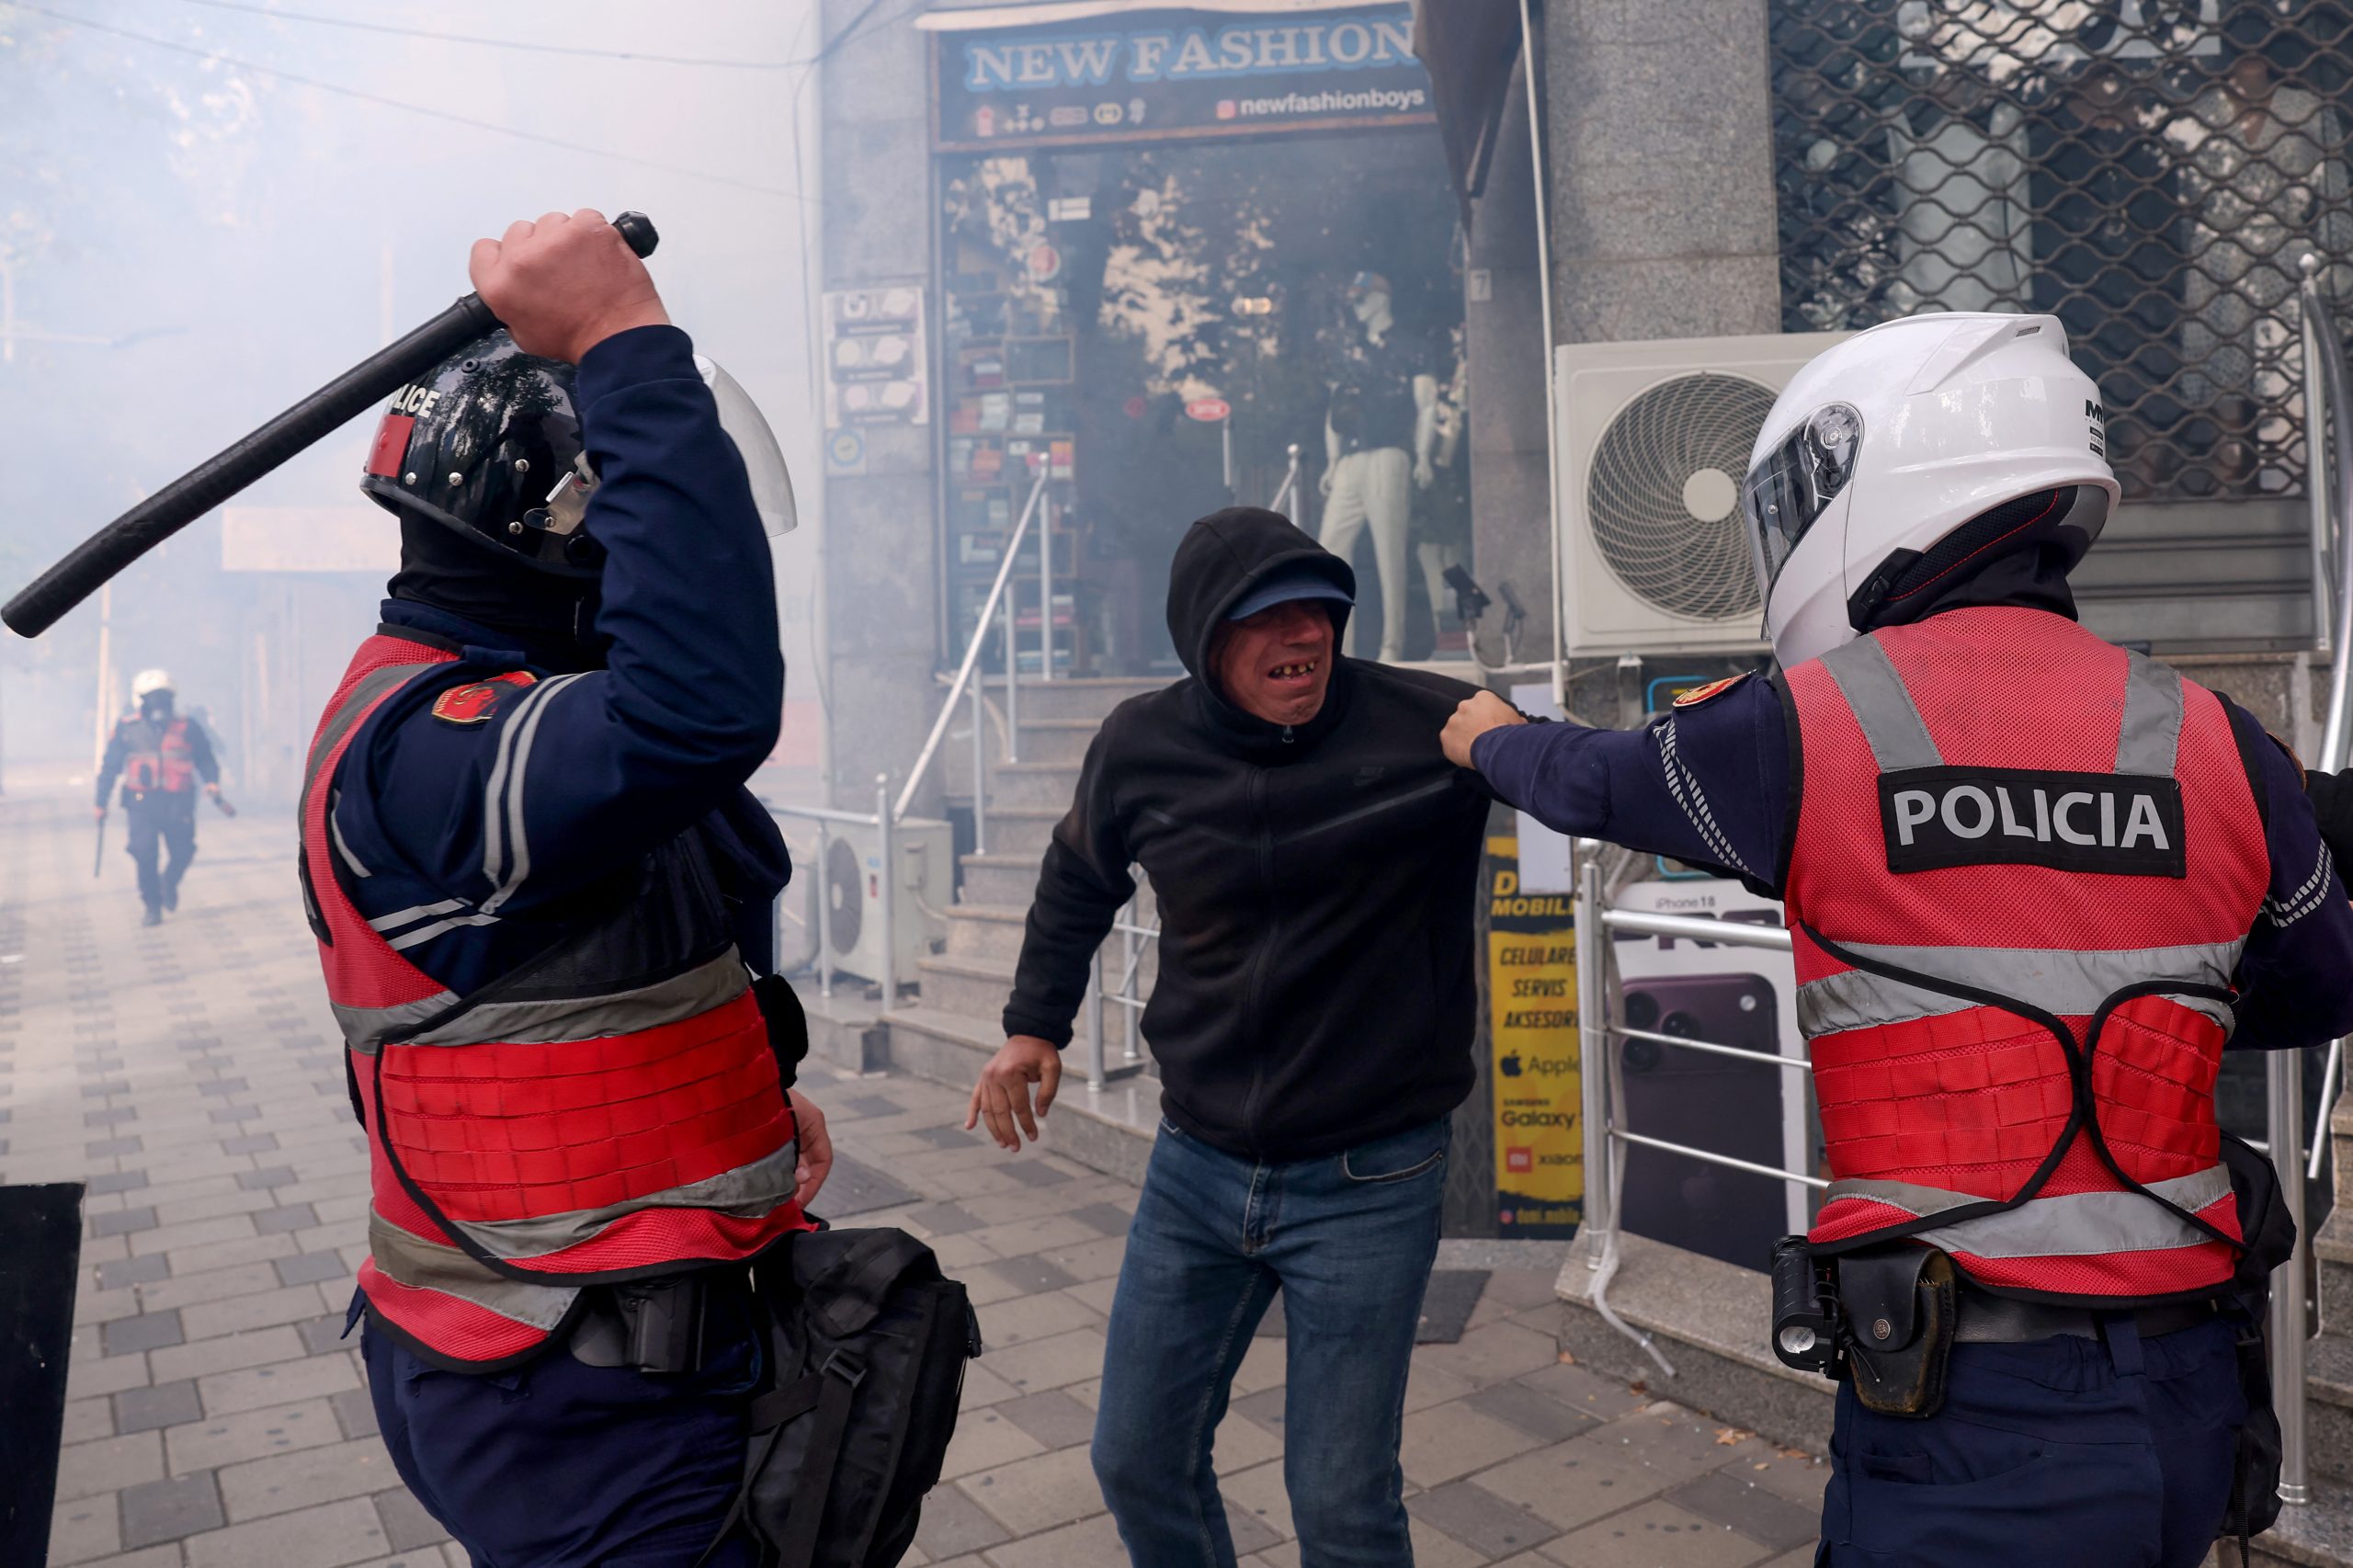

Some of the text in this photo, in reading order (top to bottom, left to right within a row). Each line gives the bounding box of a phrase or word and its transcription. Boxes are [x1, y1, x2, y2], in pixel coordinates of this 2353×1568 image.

[971, 20, 1416, 85] NEW FASHION
[1240, 88, 1425, 116] newfashionboys
[388, 383, 441, 418] OLICE
[1893, 785, 2170, 850] POLICIA
[1655, 897, 1699, 909] iPhone
[1512, 979, 1567, 997] SERVIS
[1504, 1012, 1579, 1029] AKSESOR
[1501, 1109, 1575, 1131] Galaxy
